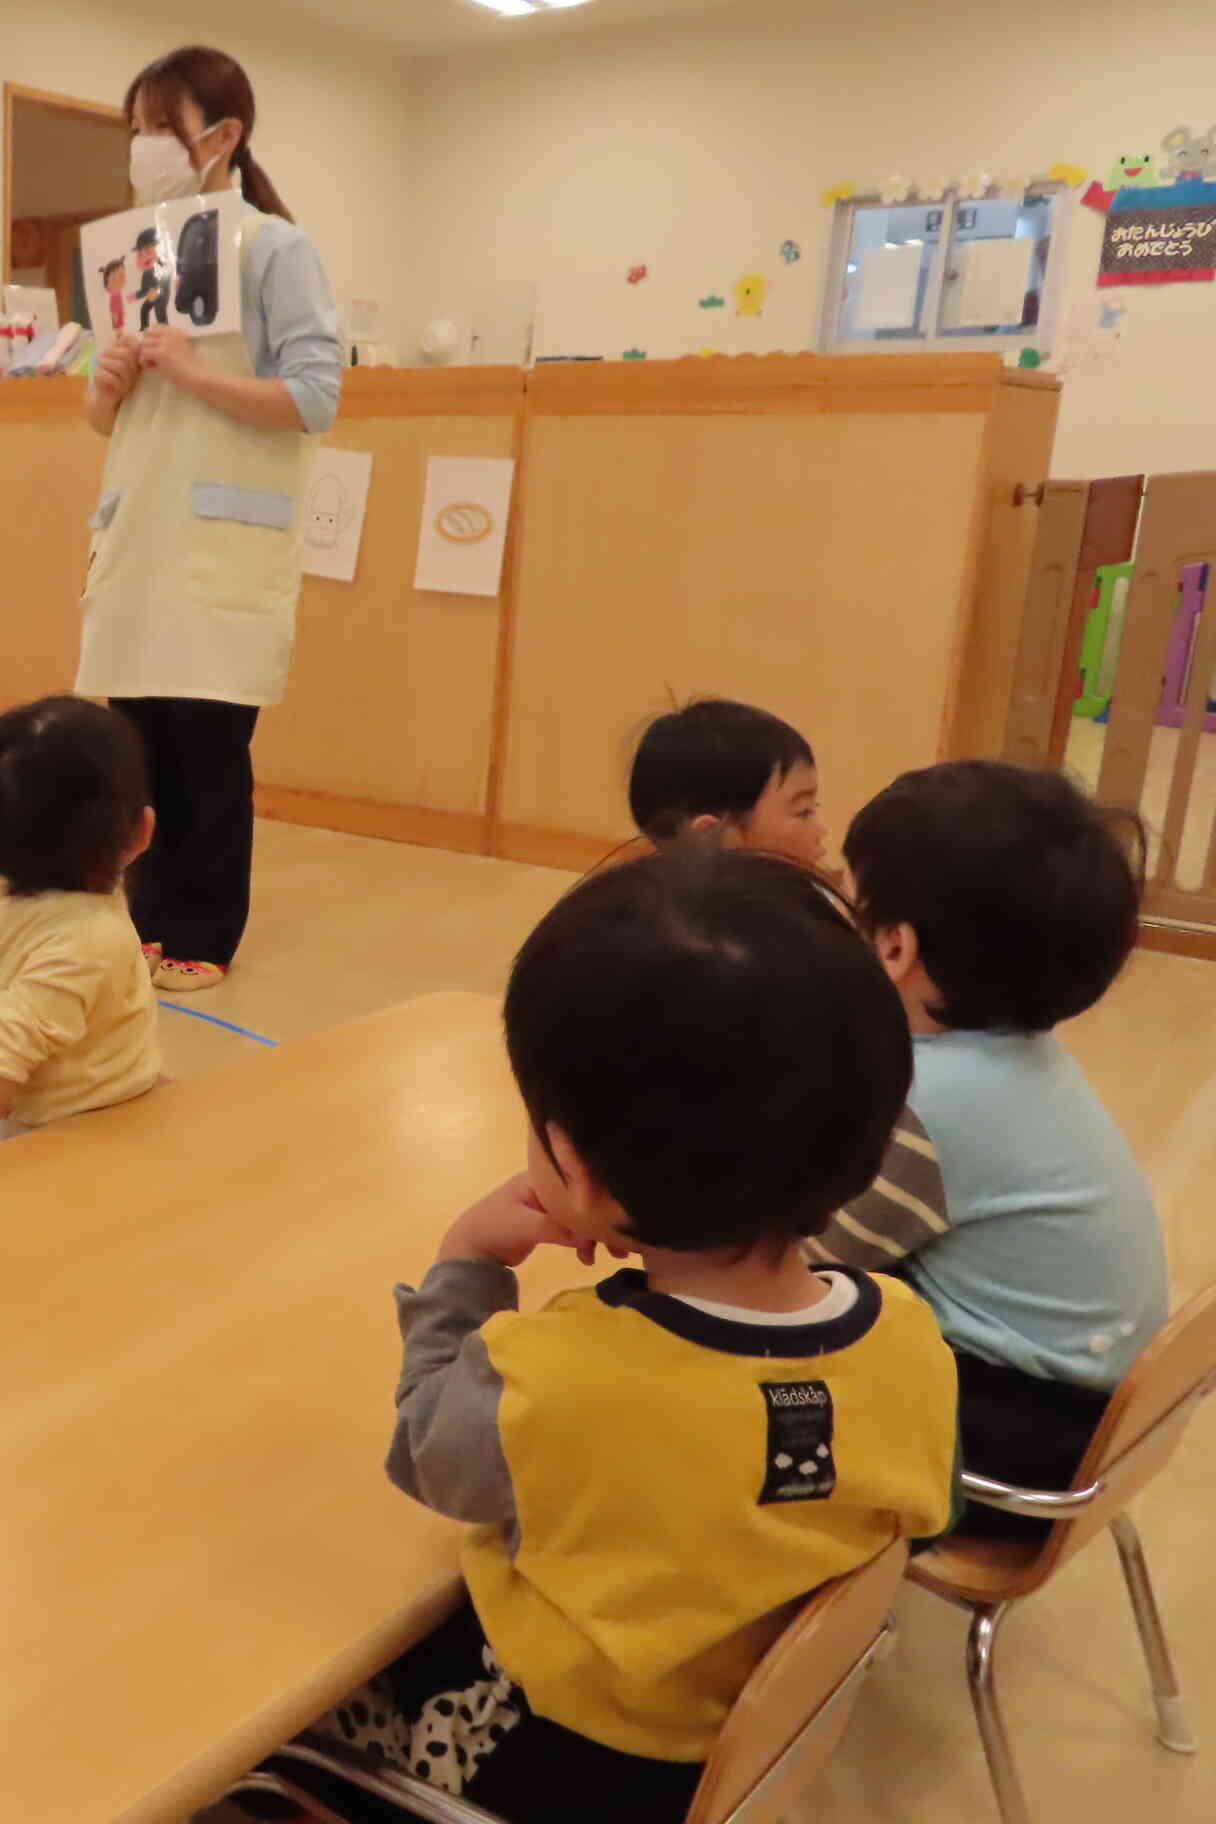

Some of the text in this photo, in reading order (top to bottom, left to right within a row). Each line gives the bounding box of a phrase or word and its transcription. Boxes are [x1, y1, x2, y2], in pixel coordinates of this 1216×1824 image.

[1117, 239, 1193, 258] おめでとう
